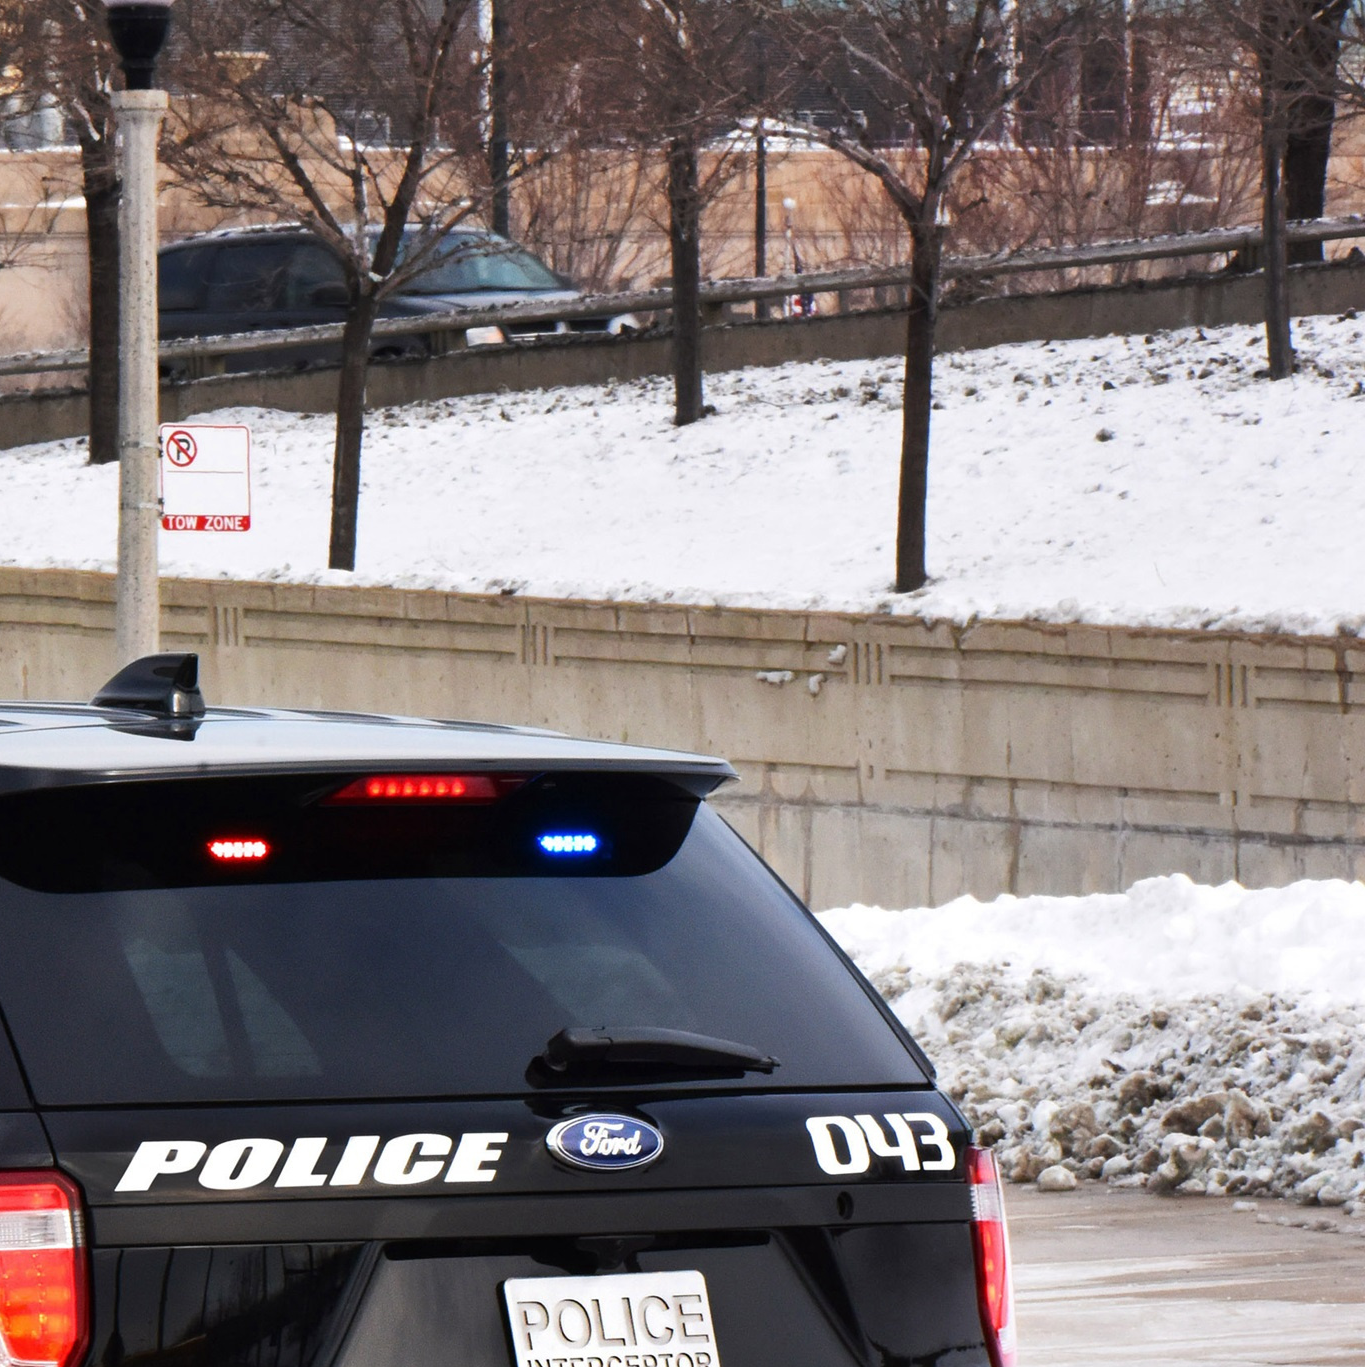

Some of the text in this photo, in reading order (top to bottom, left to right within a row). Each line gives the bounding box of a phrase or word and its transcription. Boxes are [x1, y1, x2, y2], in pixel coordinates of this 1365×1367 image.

[167, 516, 244, 531] TOW ZONE
[114, 1132, 510, 1193] POLICE
[580, 1122, 642, 1157] Ford
[805, 1112, 956, 1176] 043
[516, 1294, 710, 1351] POLICE
